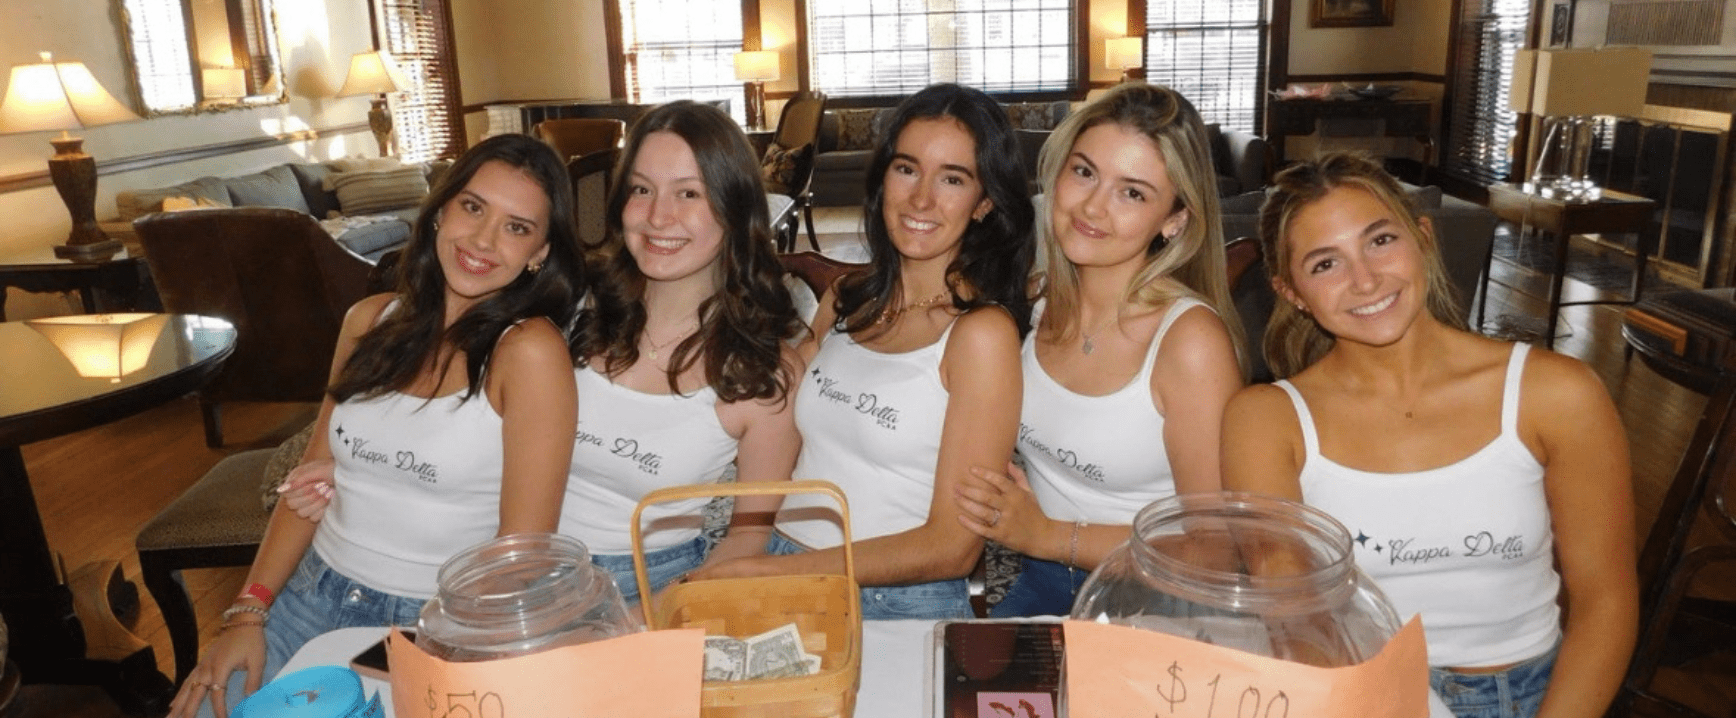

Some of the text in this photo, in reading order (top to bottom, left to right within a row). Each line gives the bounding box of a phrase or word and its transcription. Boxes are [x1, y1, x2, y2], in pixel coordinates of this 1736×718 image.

[820, 377, 900, 424] Kappa Delta
[351, 437, 437, 478] Kappa Delta
[609, 437, 664, 470] Delta
[1056, 448, 1105, 478] Delta
[1388, 530, 1524, 566] Kappa Delta
